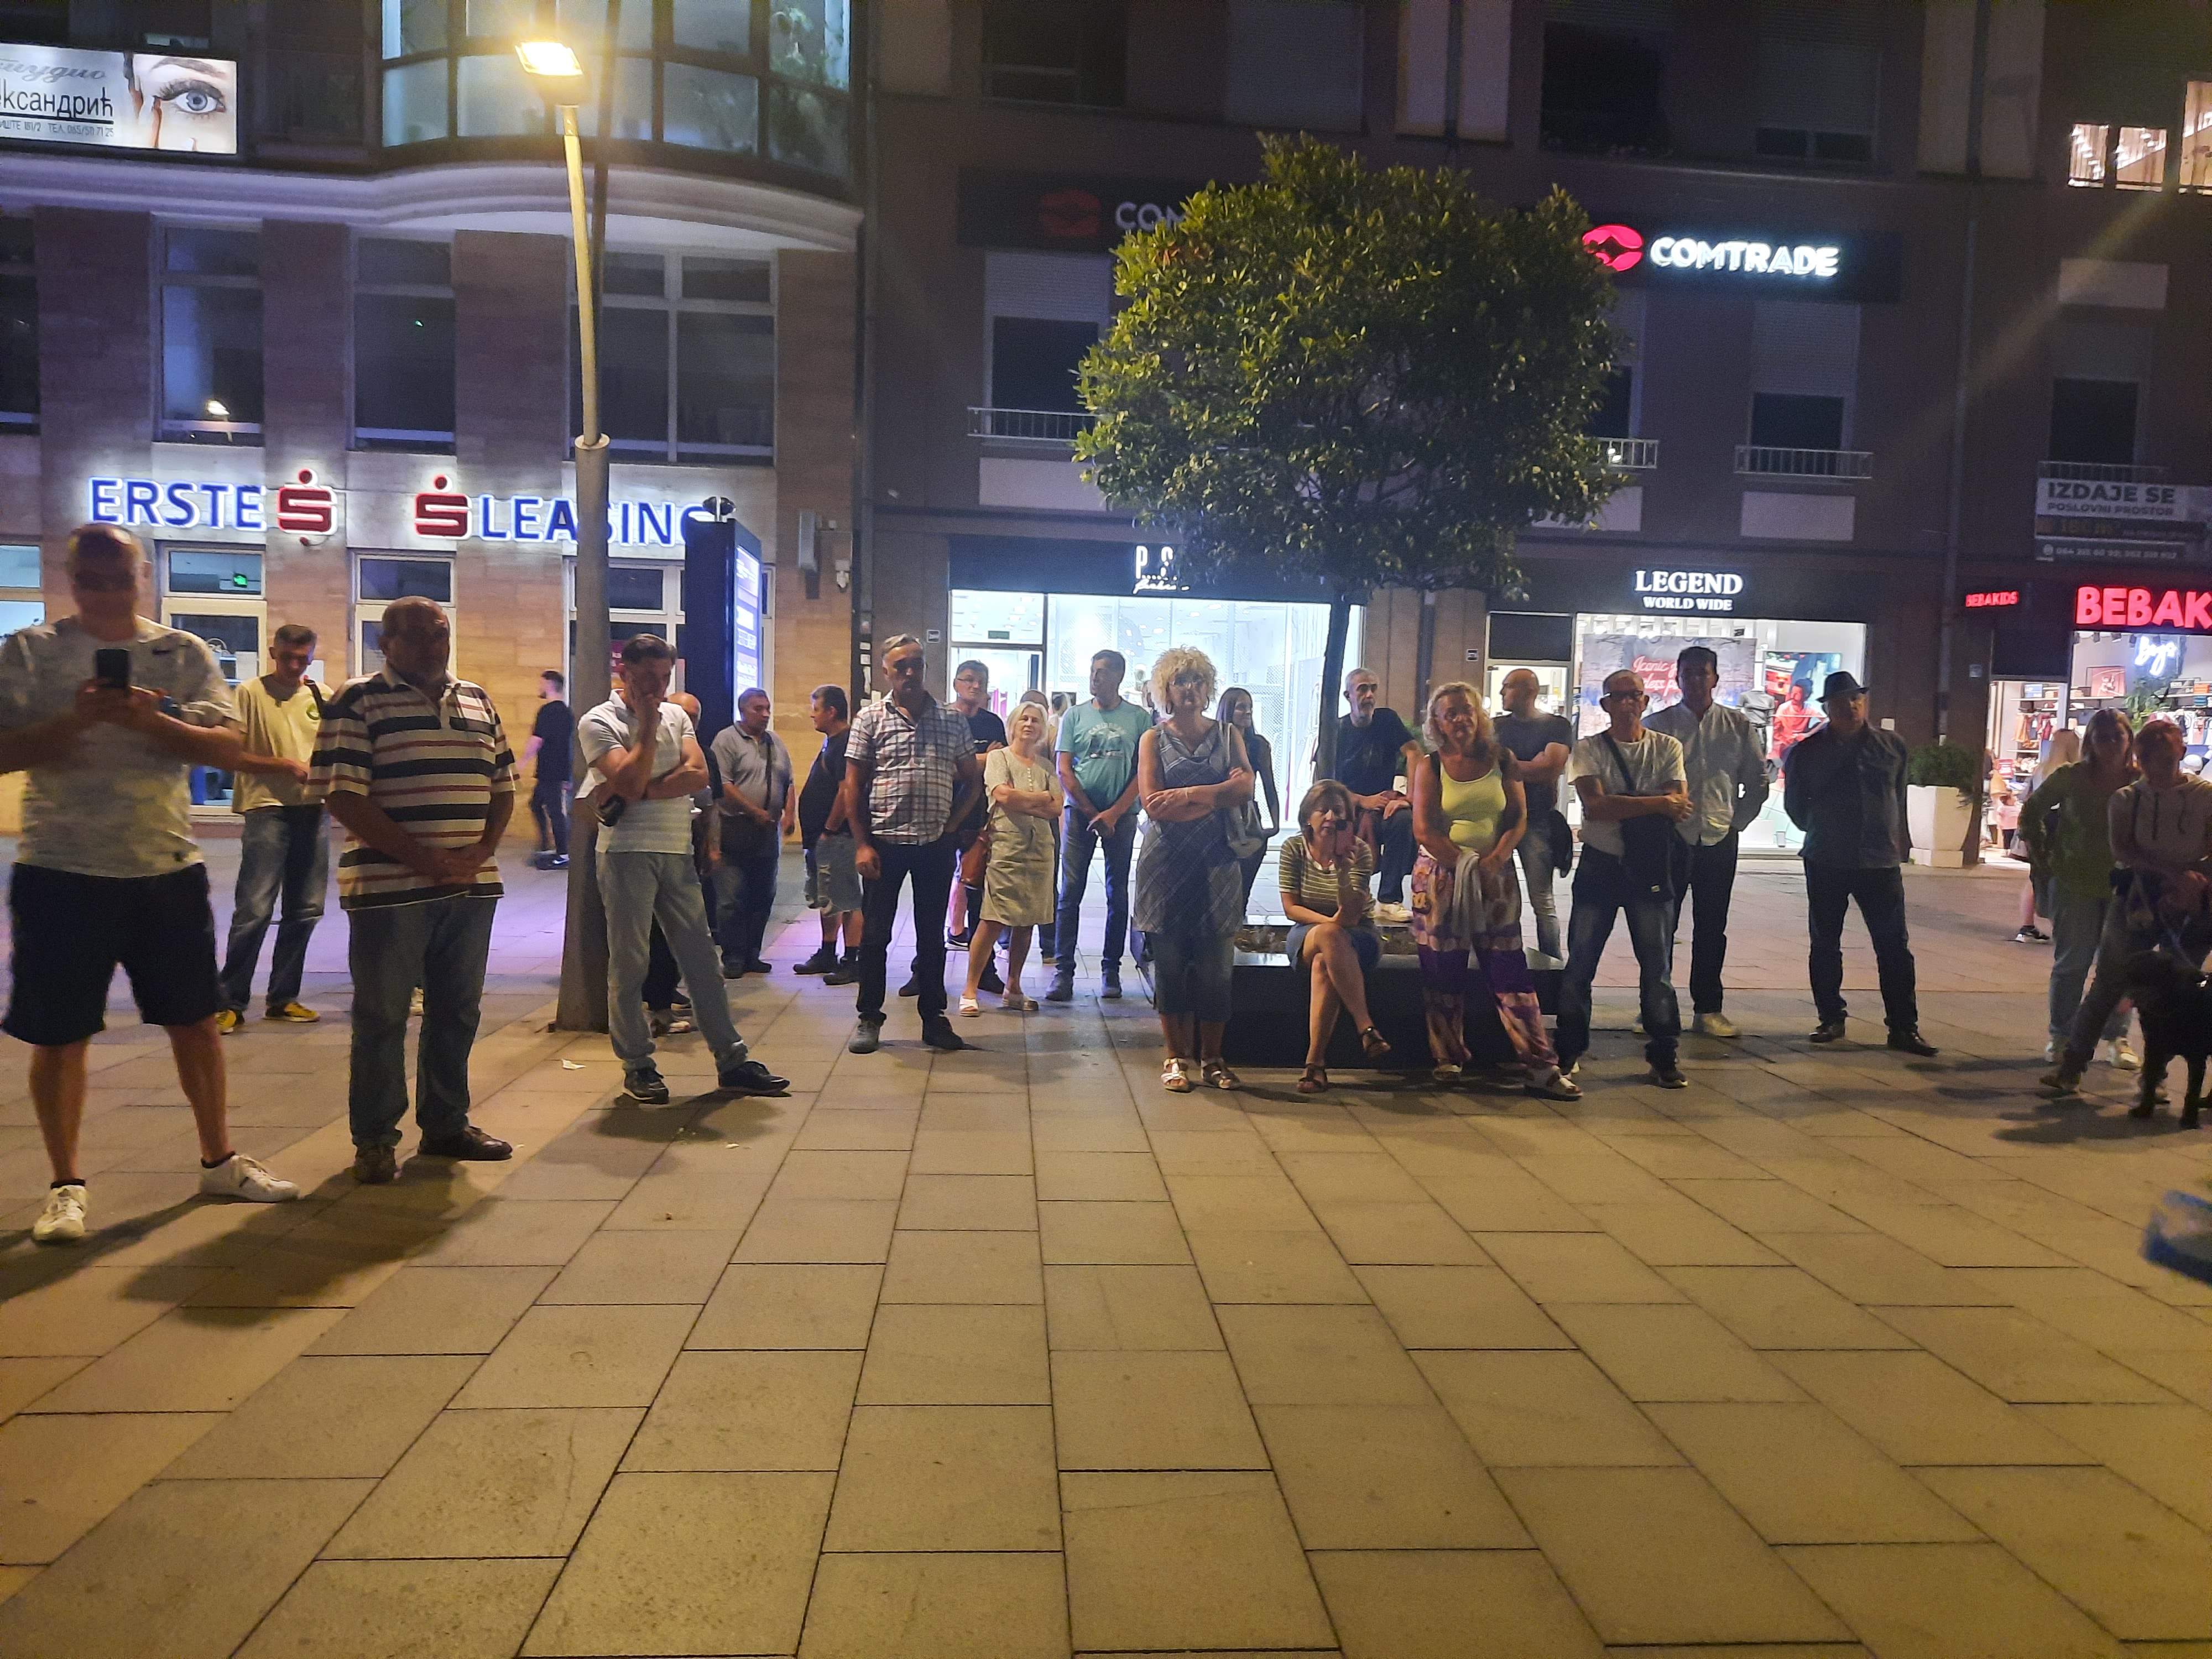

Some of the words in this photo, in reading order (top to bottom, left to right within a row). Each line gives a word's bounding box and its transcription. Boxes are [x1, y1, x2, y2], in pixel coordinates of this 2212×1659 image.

[0, 79, 113, 118] ксандрић
[1650, 237, 1839, 277] COMTRADE
[88, 476, 267, 531] ERSTE
[2048, 482, 2137, 502] IZDAJE
[2145, 487, 2176, 504] SE
[1635, 570, 1744, 594] LEGEND
[1643, 596, 1694, 609] WORLD
[1697, 598, 1733, 611] WIDE
[1966, 591, 2018, 607] BEBAKIDS
[1632, 655, 1669, 672] Iconic
